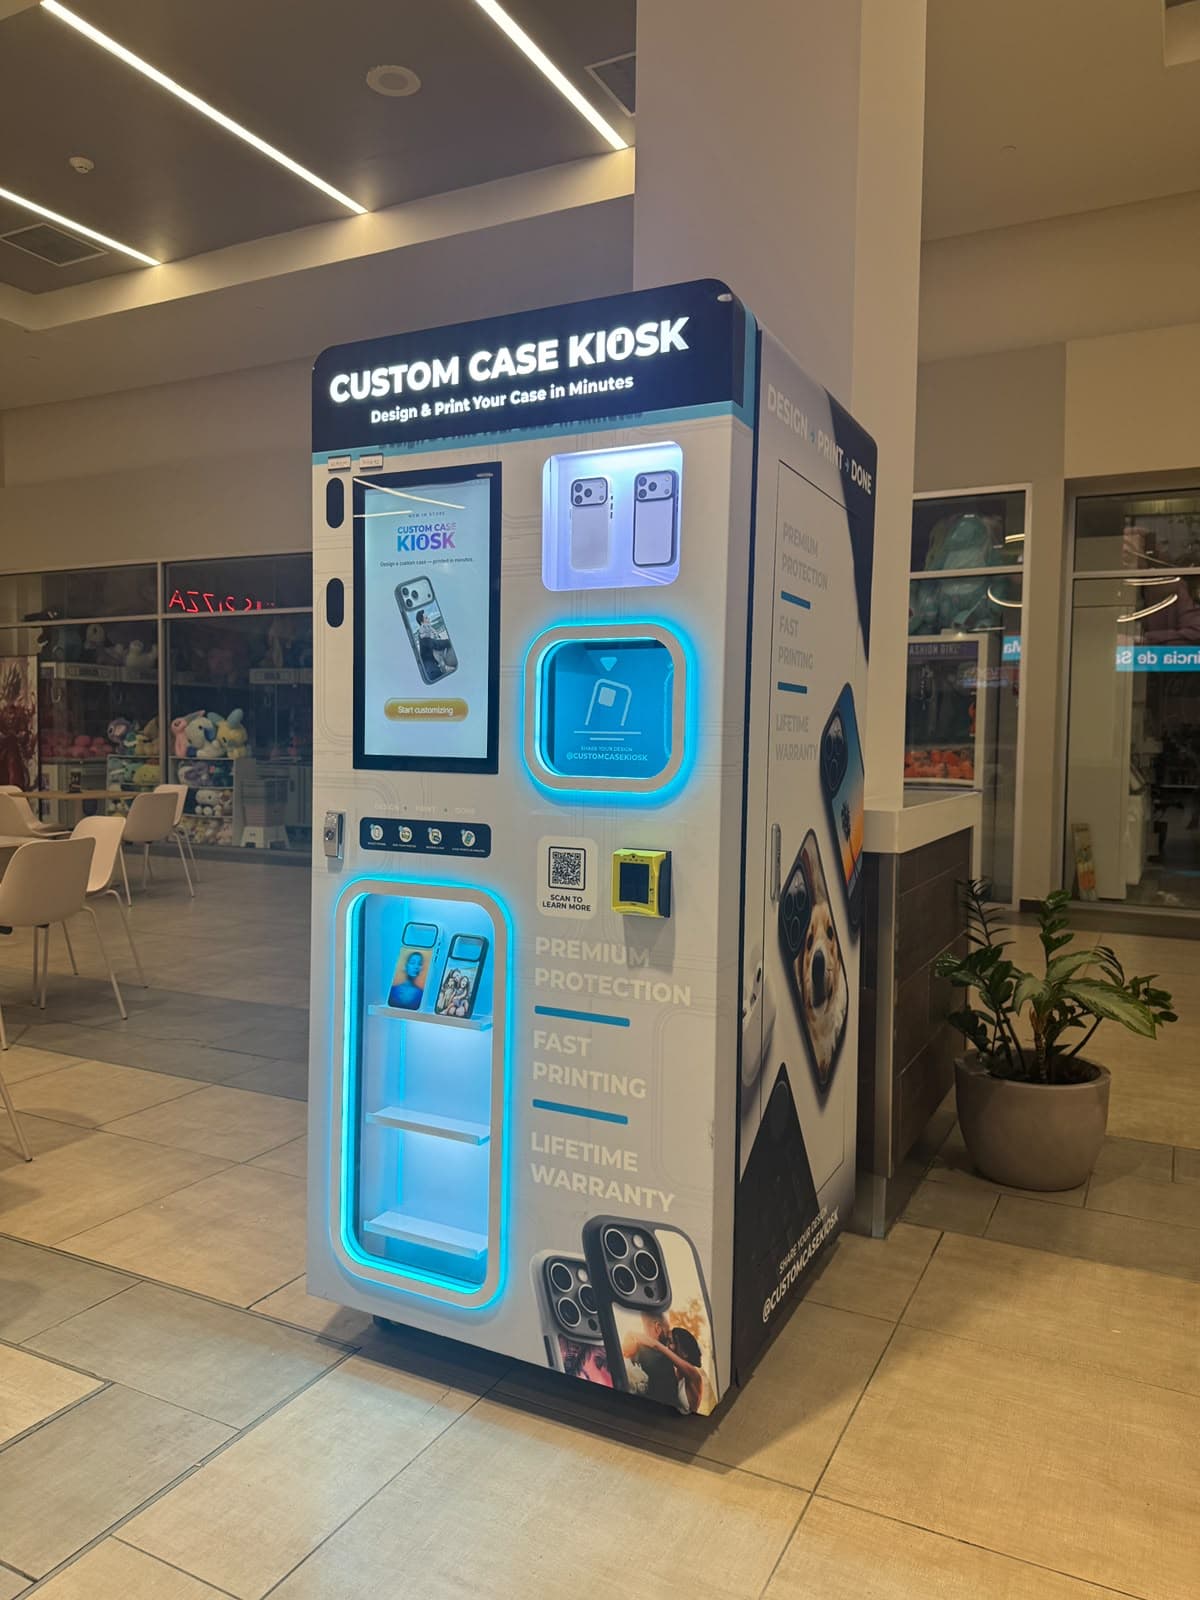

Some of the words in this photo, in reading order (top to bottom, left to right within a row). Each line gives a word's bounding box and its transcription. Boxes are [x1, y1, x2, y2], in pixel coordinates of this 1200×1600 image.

[329, 355, 460, 404] CUSTOM
[468, 339, 559, 382] CASE
[568, 316, 690, 368] KIOSK
[371, 405, 418, 424] Design
[421, 402, 432, 418] &
[434, 397, 471, 416] Print
[472, 393, 507, 410] Your
[510, 388, 547, 405] Case
[550, 382, 566, 399] in
[569, 376, 634, 397] Minutes
[767, 383, 808, 440] DESIGN
[817, 429, 844, 470] PRINT
[851, 458, 872, 496] DONE
[397, 525, 432, 534] CUSTOM
[434, 522, 456, 531] CASE
[397, 532, 456, 552] KIOSK
[783, 522, 818, 557] PREMIUM
[781, 552, 829, 591] PROTECTION
[779, 615, 799, 637] FAST
[778, 646, 814, 671] PRINTING
[398, 706, 414, 714] Start
[415, 706, 454, 717] customizing
[776, 713, 809, 734] LIFETIME
[566, 752, 648, 761] @CUSTOMCASEKIOSK
[776, 743, 819, 761] WARRANTY
[542, 901, 567, 909] LEARN
[569, 903, 591, 912] MORE
[550, 894, 571, 902] SCAN
[535, 936, 650, 968] PREMIUM
[535, 967, 691, 1006] PROTECTION
[533, 1029, 592, 1057] FAST
[532, 1061, 647, 1099] PRINTING
[530, 1131, 638, 1172] LIFETIME
[530, 1162, 675, 1212] WARRANTY
[762, 1205, 839, 1323] @CUSTOMCASEKIOSK
